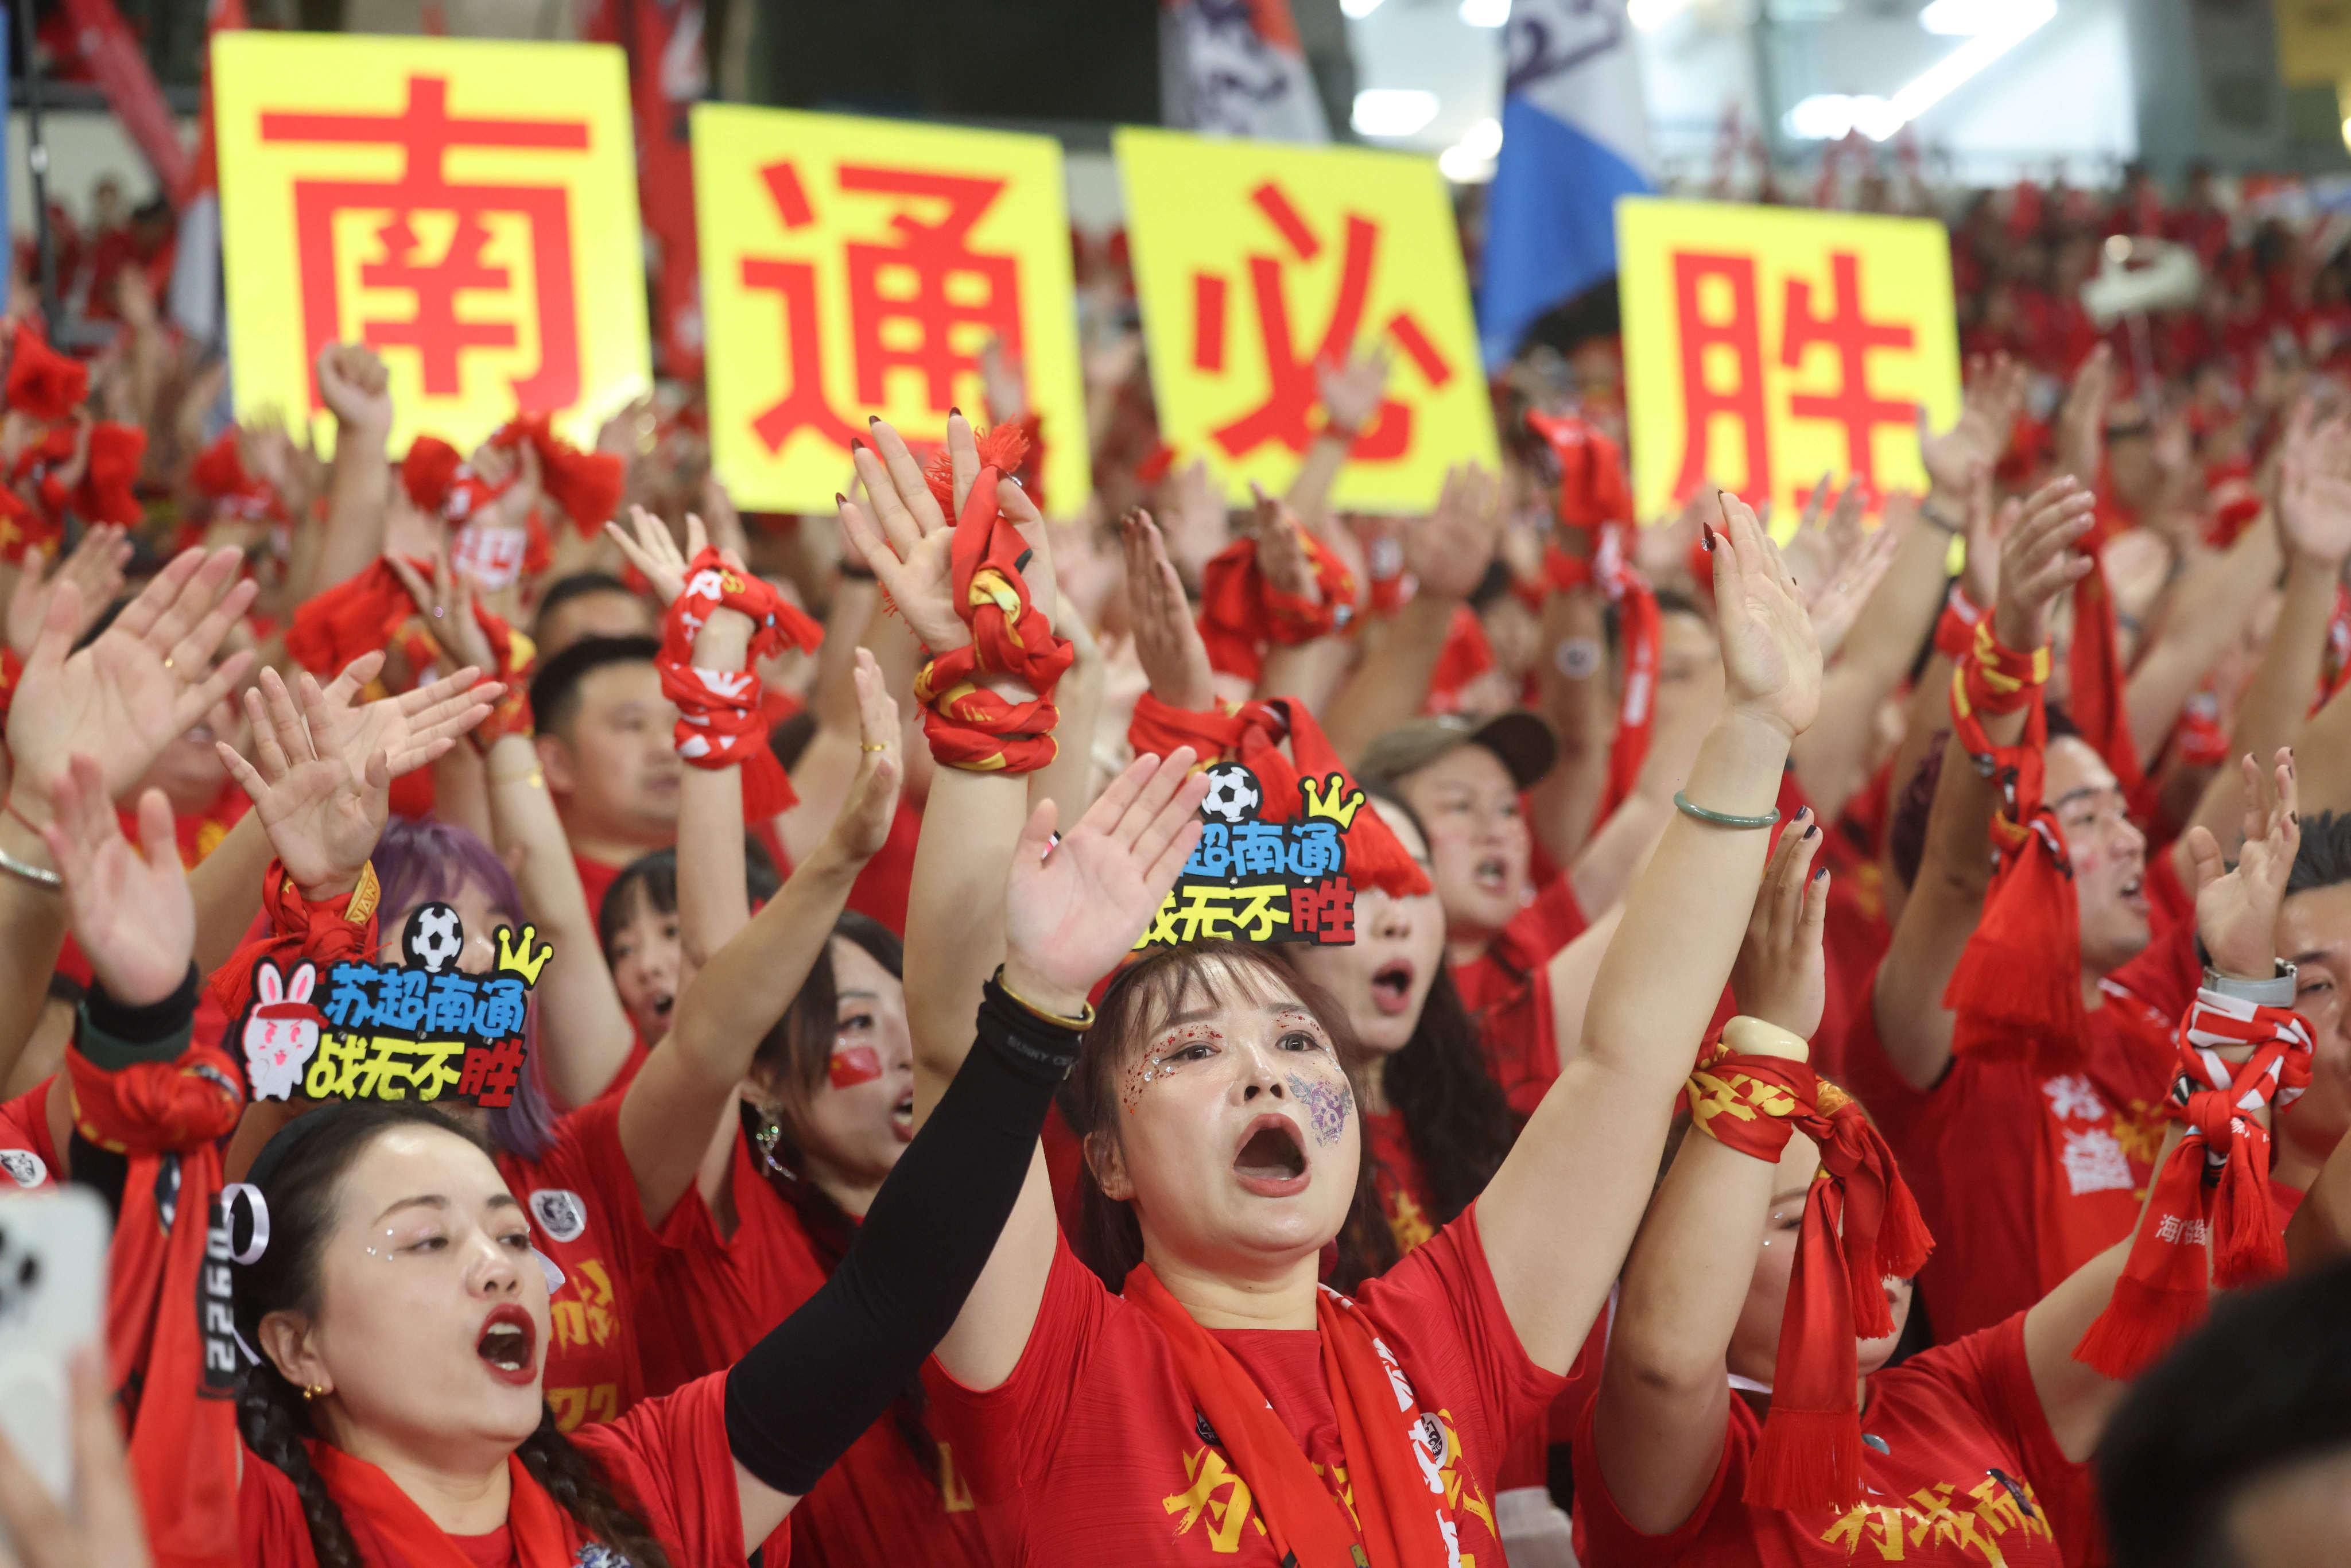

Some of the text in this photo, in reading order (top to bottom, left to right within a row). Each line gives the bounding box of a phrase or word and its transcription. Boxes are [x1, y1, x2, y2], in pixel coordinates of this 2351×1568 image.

[260, 76, 589, 407] 南
[740, 161, 1031, 465] 通
[1194, 181, 1452, 464] 必
[1670, 251, 1920, 514] 胜
[306, 1034, 525, 1108] 战无不胜
[325, 964, 525, 1038] 苏超南通
